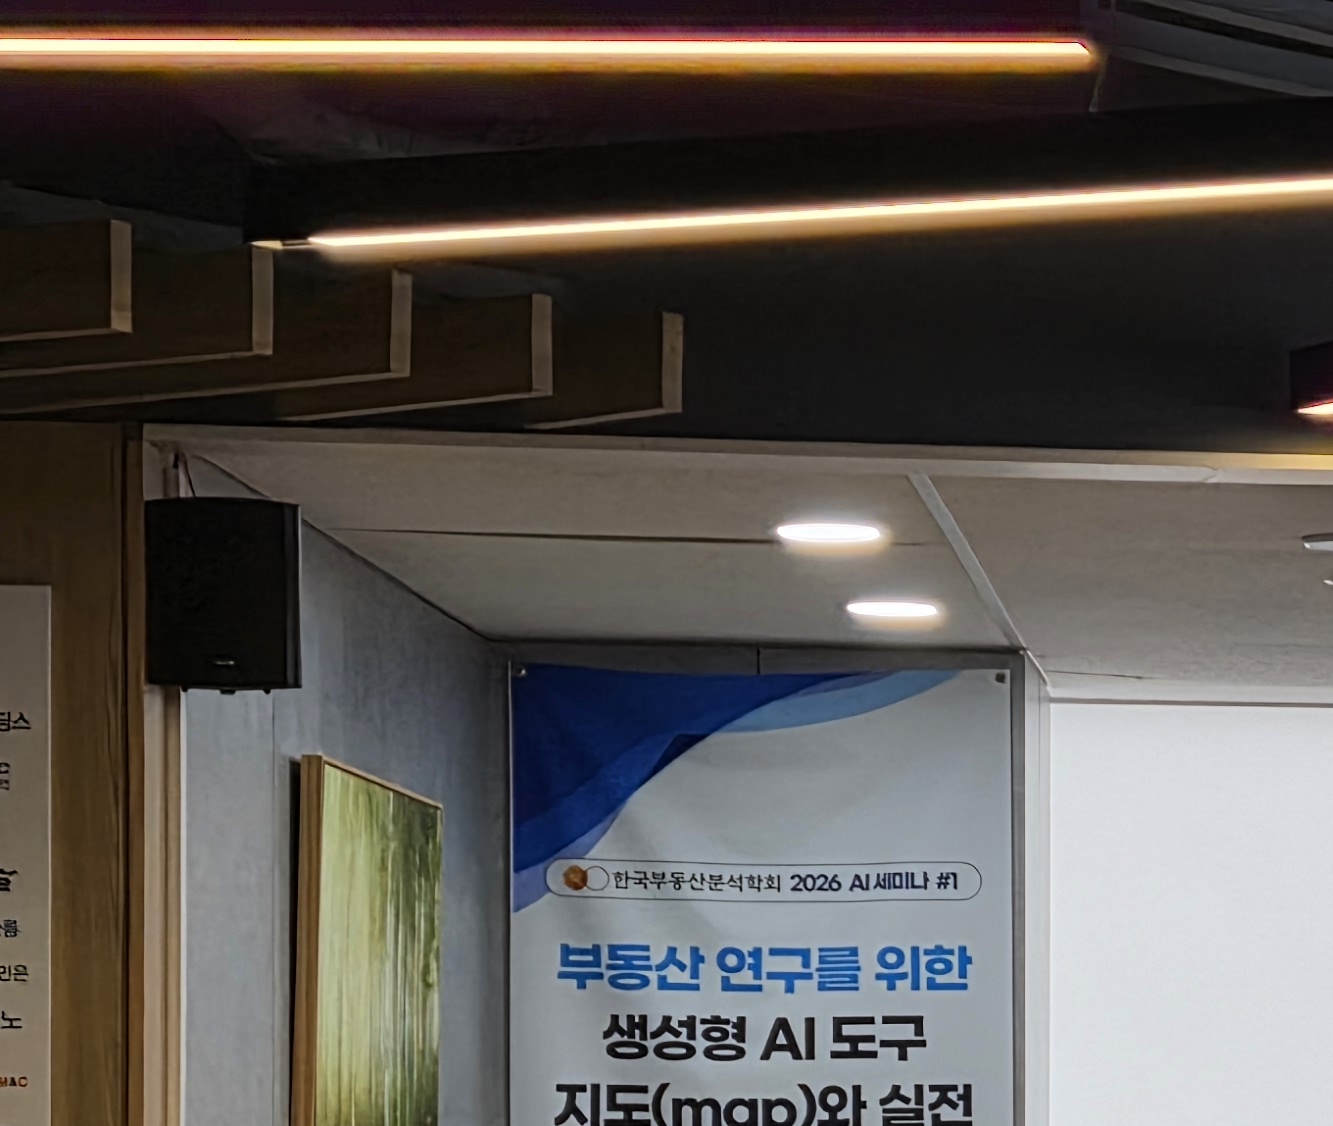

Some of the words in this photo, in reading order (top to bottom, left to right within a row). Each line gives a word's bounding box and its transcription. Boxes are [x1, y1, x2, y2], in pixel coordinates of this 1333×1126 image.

[613, 870, 781, 893] 한국부동산분석학회
[790, 874, 842, 892] 2026
[936, 872, 958, 891] #1
[557, 943, 705, 992] 부동산
[716, 945, 862, 994] 연구를
[875, 944, 973, 992] 위한
[602, 1014, 746, 1061] 생성형
[760, 1017, 814, 1061] AI
[829, 1015, 927, 1062] 도구
